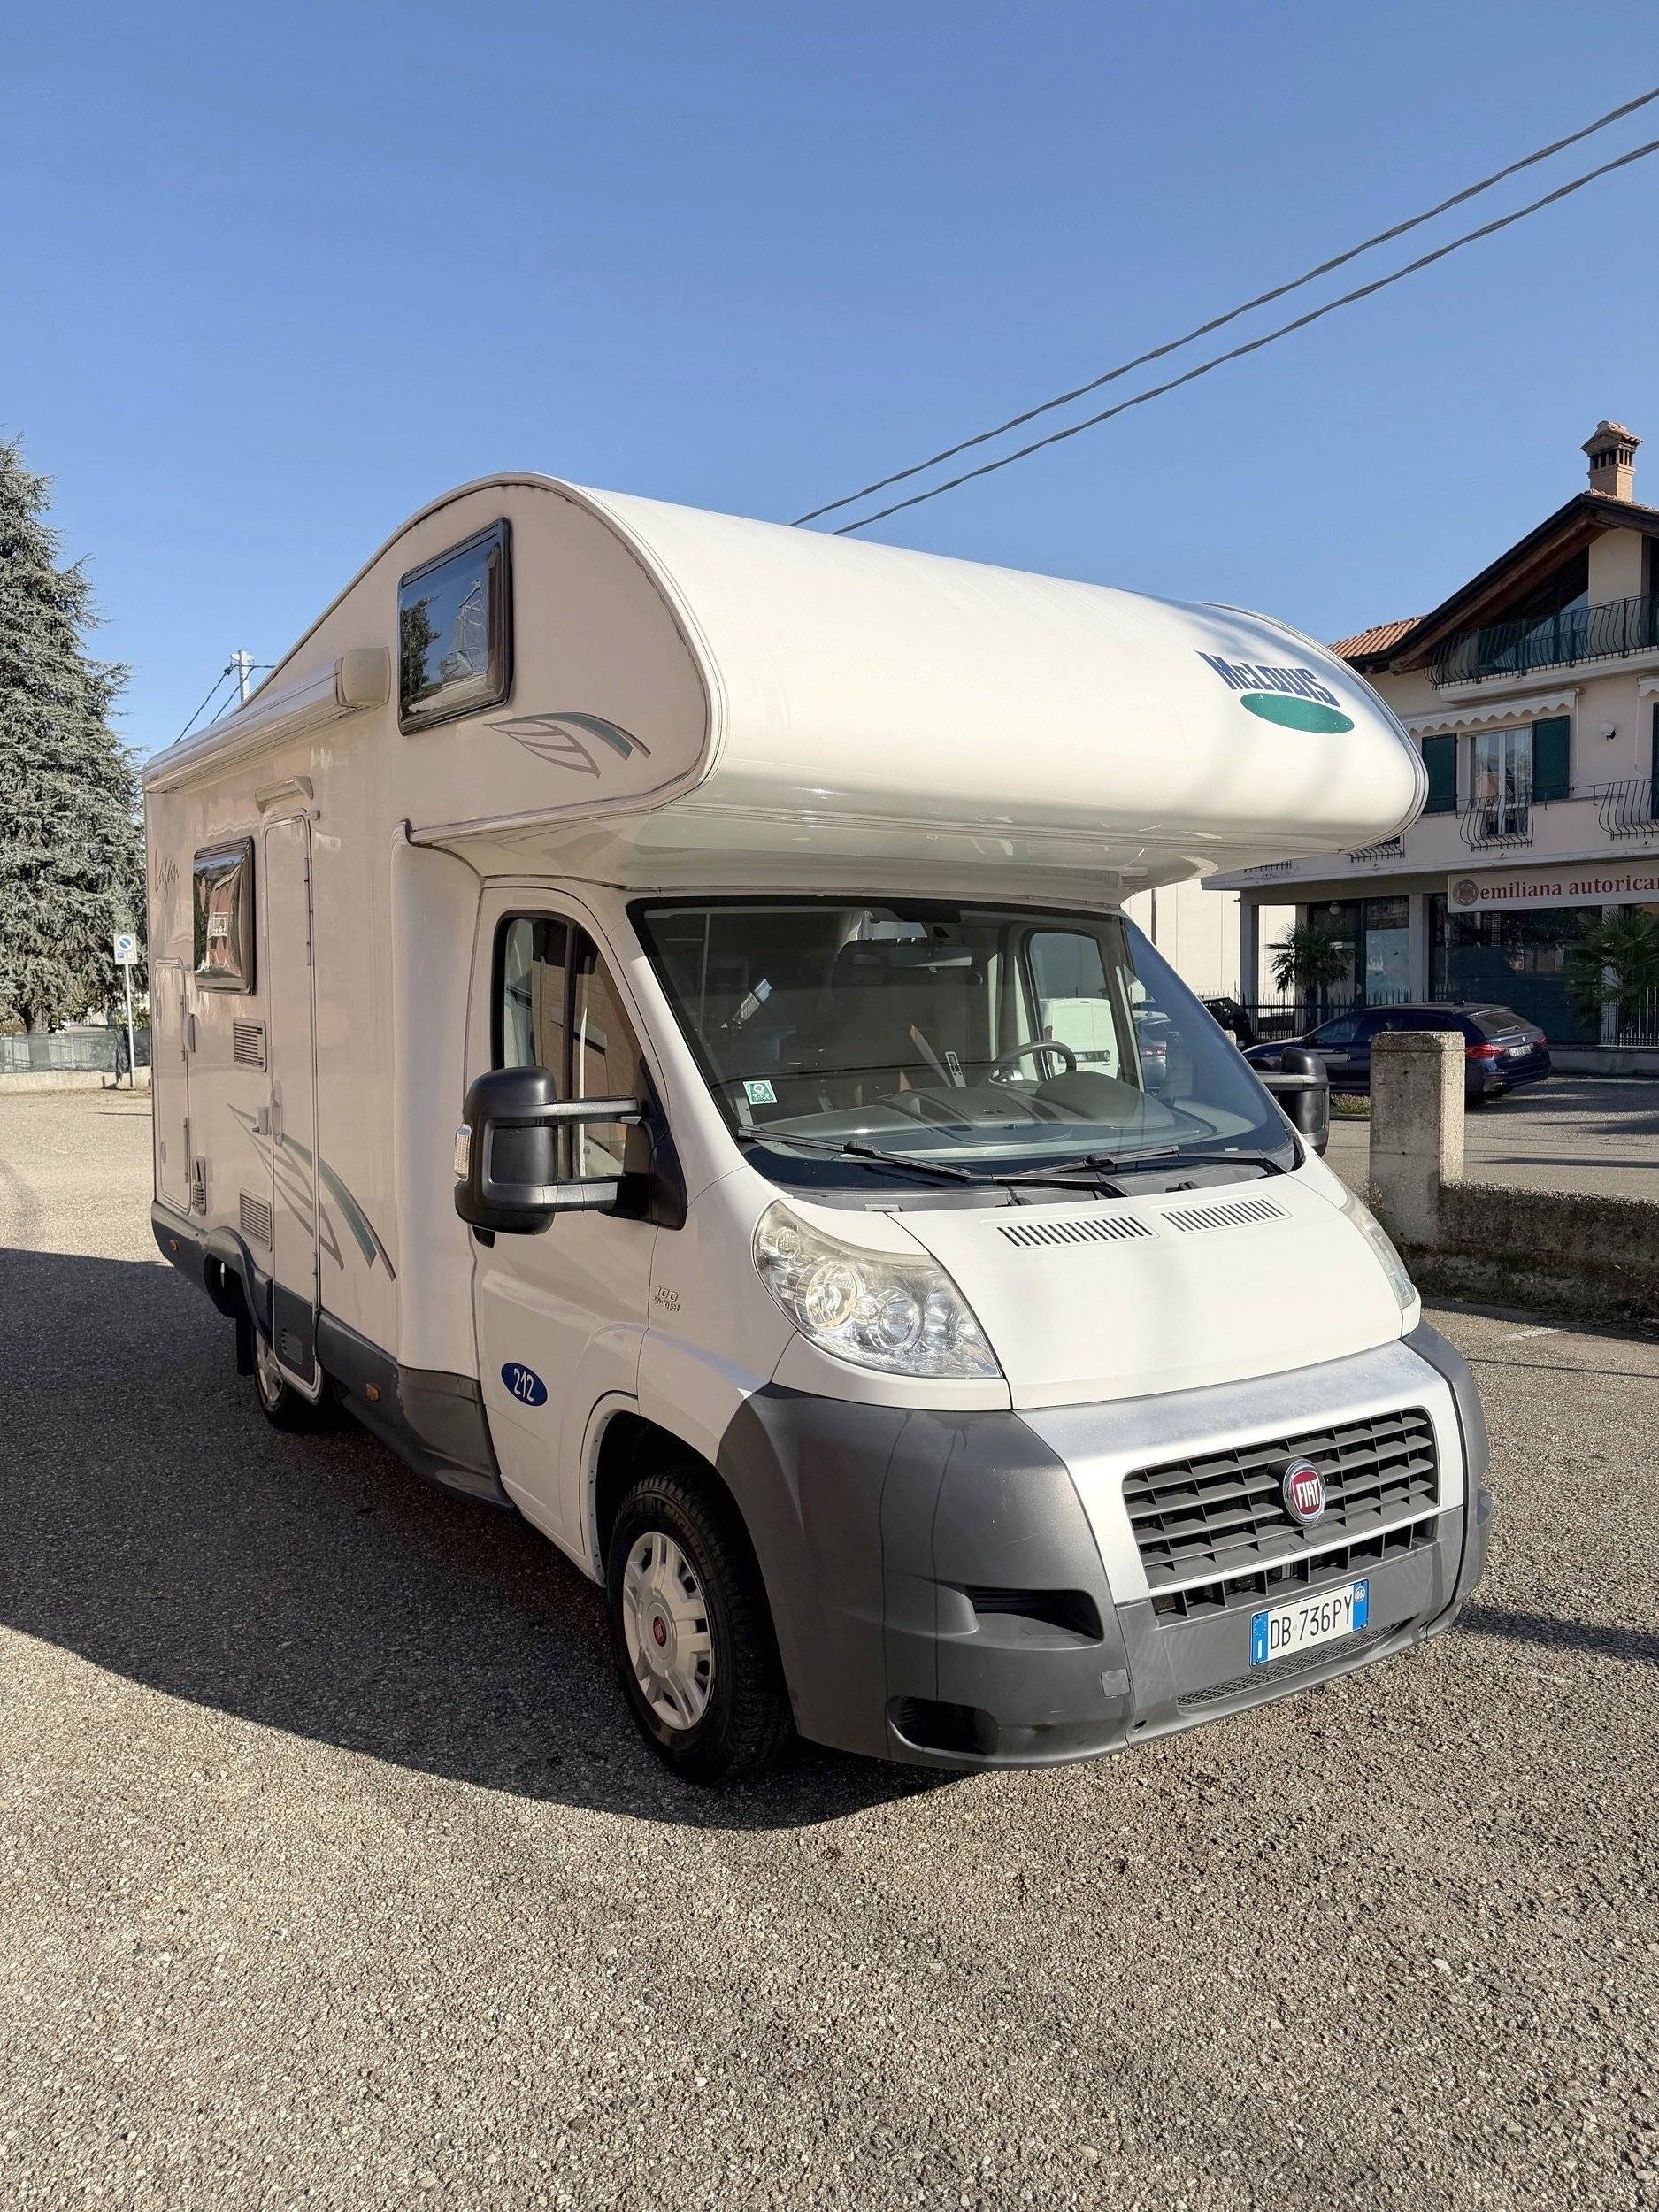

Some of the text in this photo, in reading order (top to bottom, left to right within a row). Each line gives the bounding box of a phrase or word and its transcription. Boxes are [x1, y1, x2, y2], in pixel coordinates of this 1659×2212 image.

[1480, 881, 1562, 900] emiliana
[513, 1368, 534, 1402] 212
[1295, 1479, 1319, 1509] FIAT
[1270, 1594, 1352, 1650] DB 736PY
